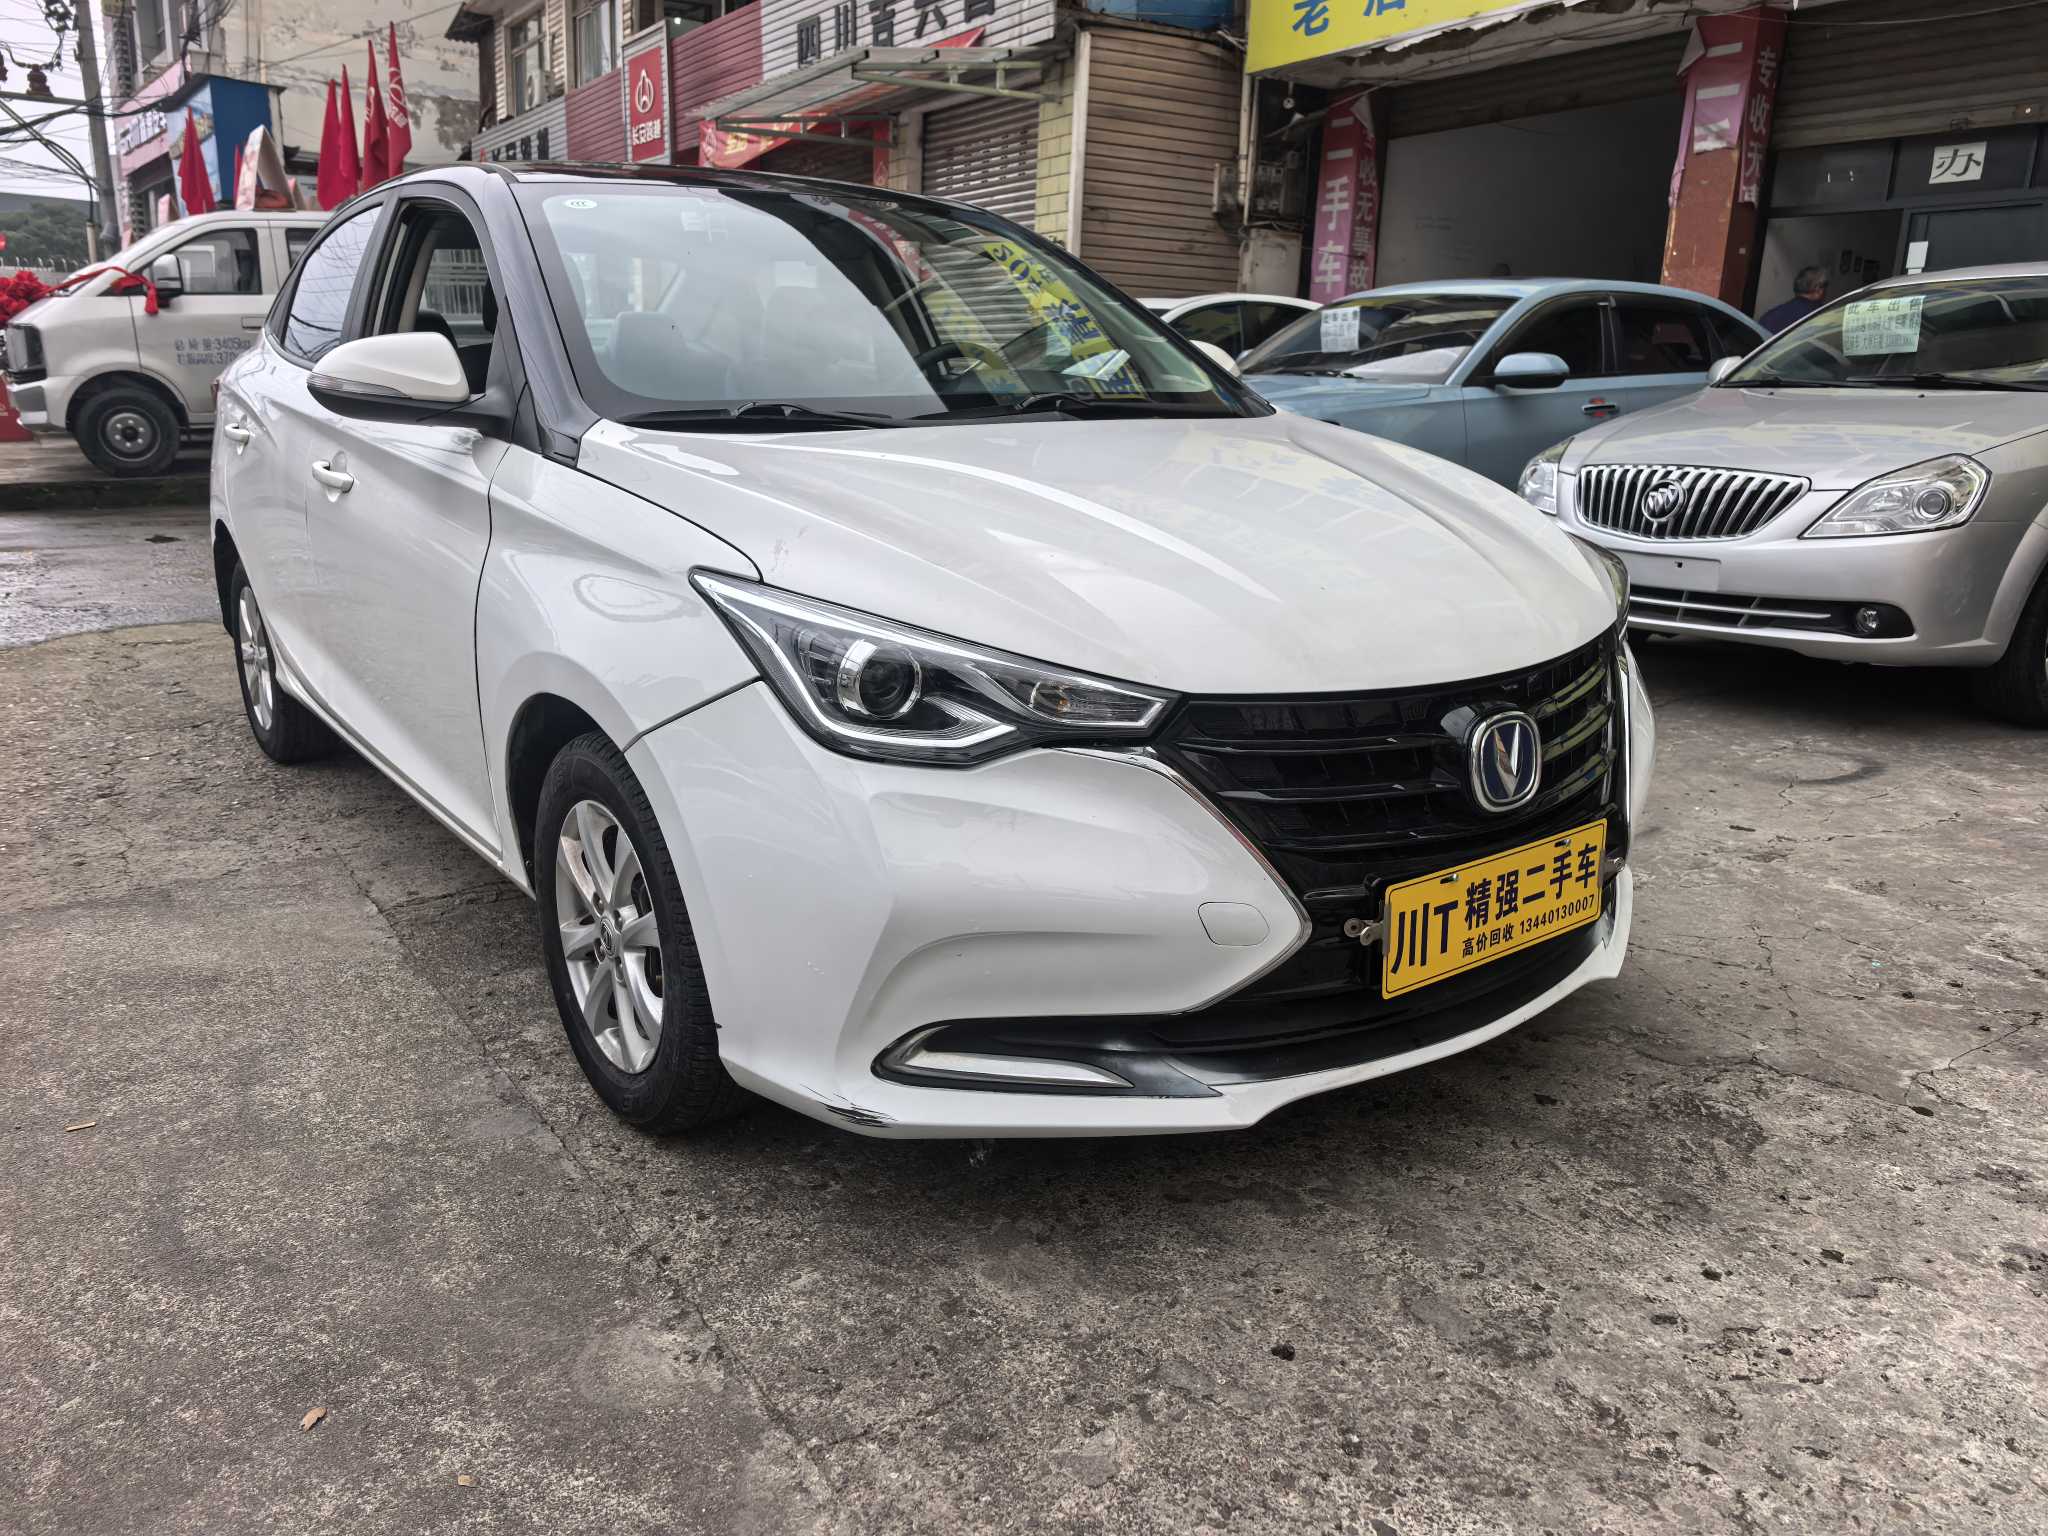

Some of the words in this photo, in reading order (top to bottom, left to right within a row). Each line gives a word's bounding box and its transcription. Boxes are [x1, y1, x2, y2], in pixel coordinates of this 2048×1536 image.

[1932, 149, 1982, 179] 办
[1314, 116, 1354, 294] 二手车
[1462, 922, 1514, 958] 高价回收
[1519, 893, 1595, 935] 13440130007
